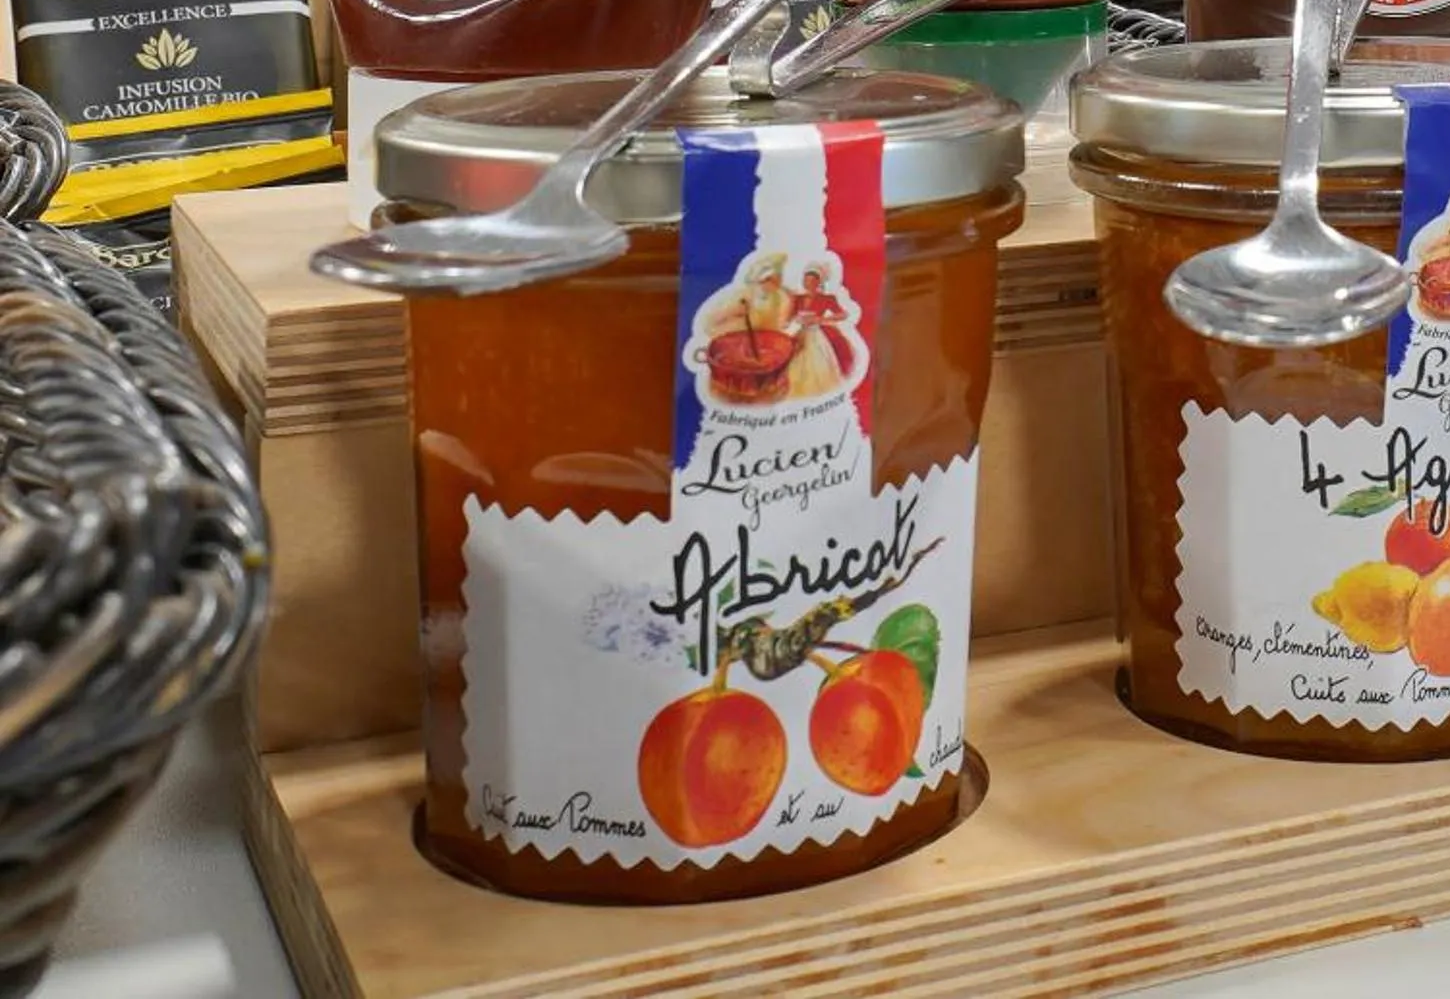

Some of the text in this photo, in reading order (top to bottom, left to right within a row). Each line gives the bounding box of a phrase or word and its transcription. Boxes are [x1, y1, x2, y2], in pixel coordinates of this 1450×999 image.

[97, 2, 228, 31] EXCELLENCE
[82, 92, 217, 121] CAMOMILLE
[117, 75, 222, 101] INFUSION
[709, 392, 846, 429] Fabriqué en France
[681, 420, 850, 496] Lucien
[1300, 429, 1343, 507] 4
[741, 458, 860, 530] Georgelin
[650, 494, 920, 676] Abricot
[1355, 688, 1395, 704] aux
[512, 812, 558, 830] aux
[558, 791, 647, 838] Pommes
[776, 787, 805, 828] et
